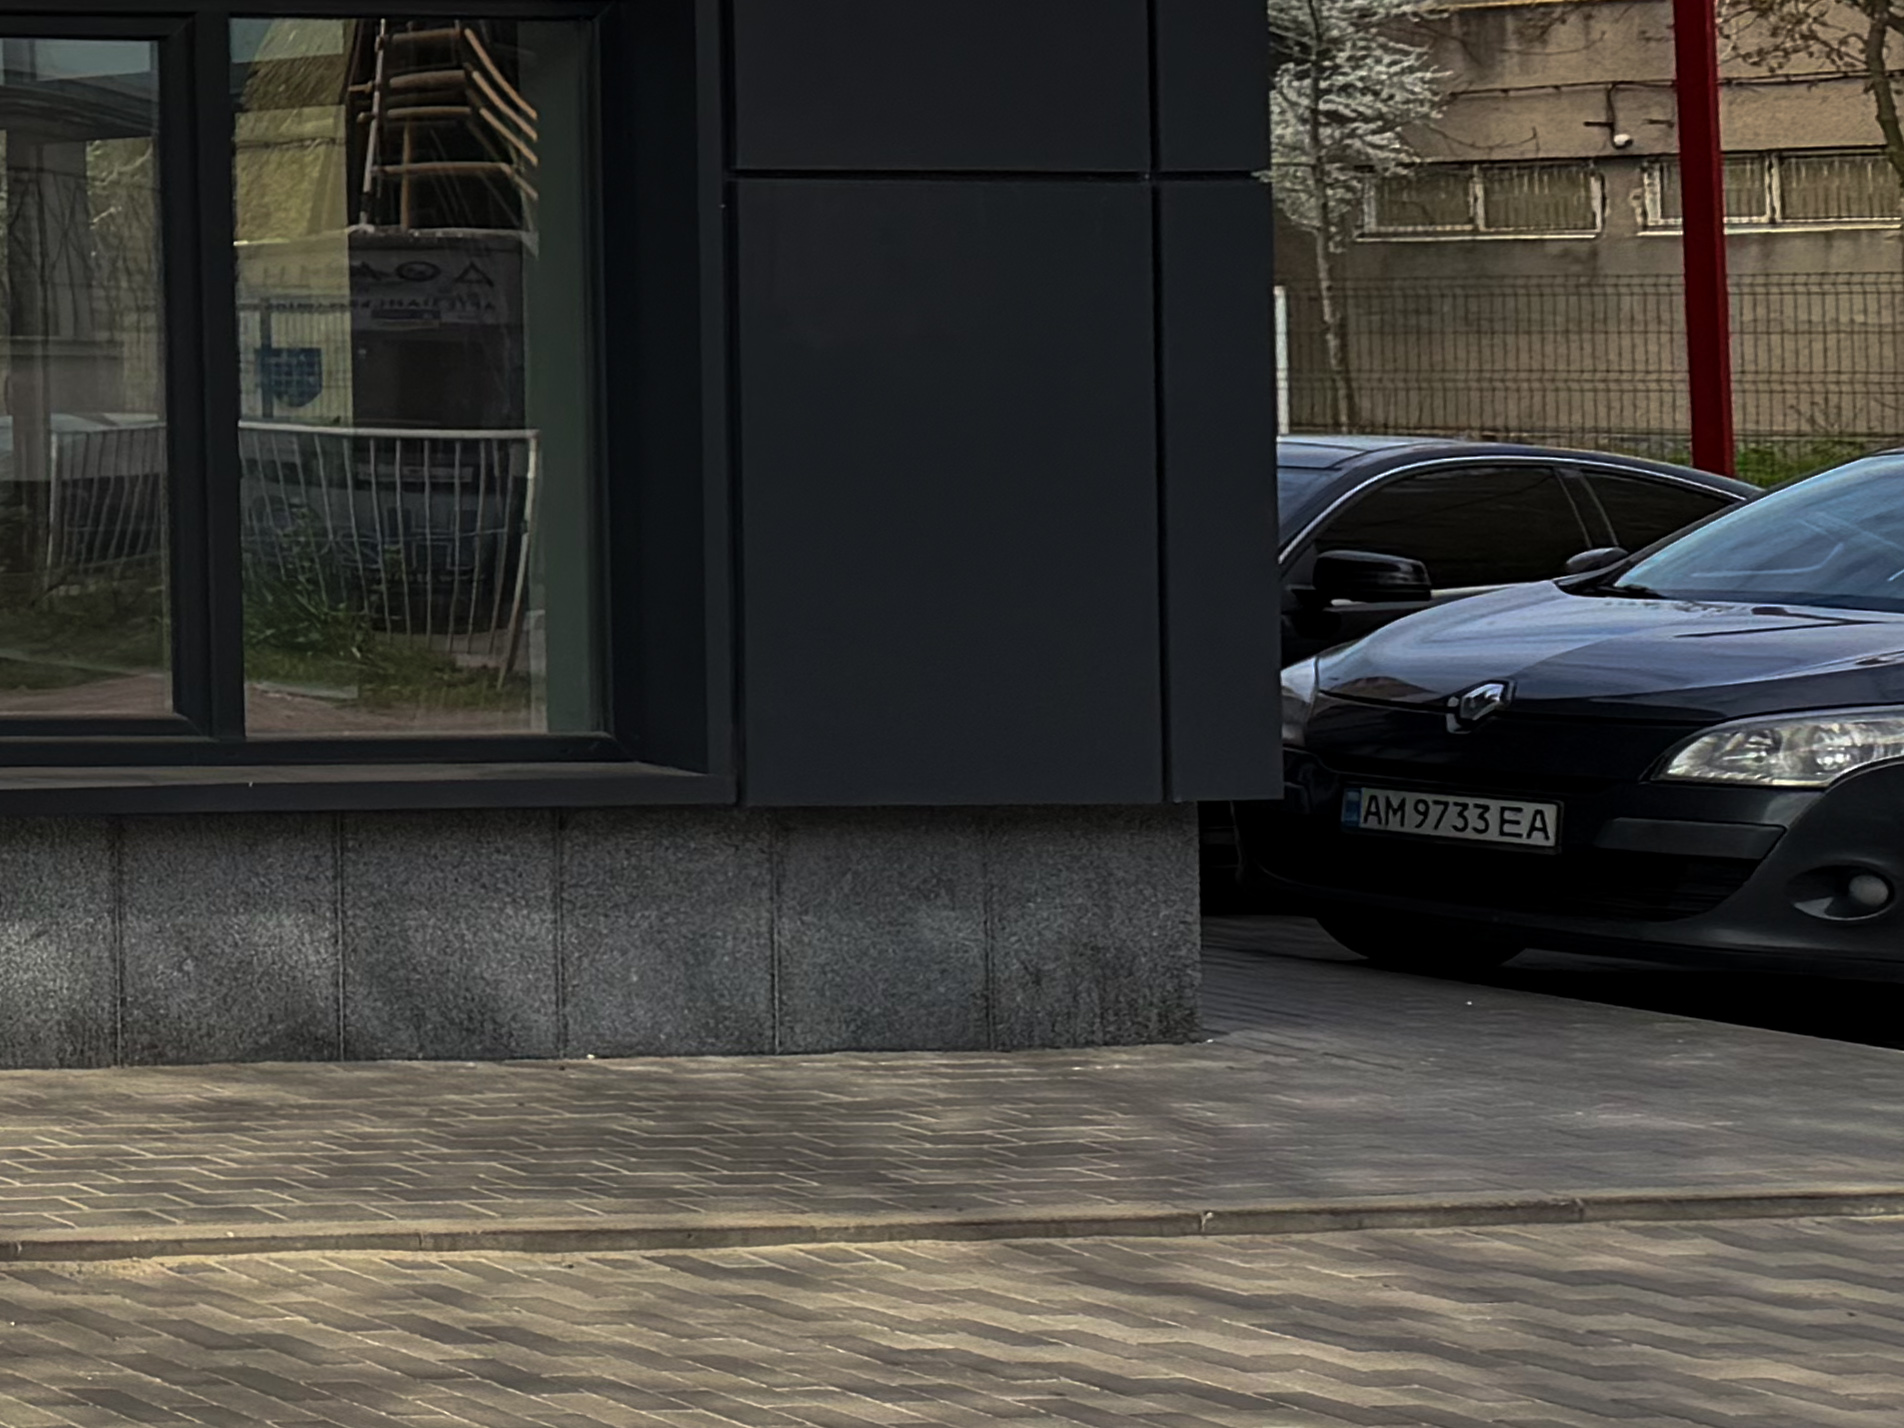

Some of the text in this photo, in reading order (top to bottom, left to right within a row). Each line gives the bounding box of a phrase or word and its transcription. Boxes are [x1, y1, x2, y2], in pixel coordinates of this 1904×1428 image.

[1362, 795, 1550, 841] AM 9733 EA
